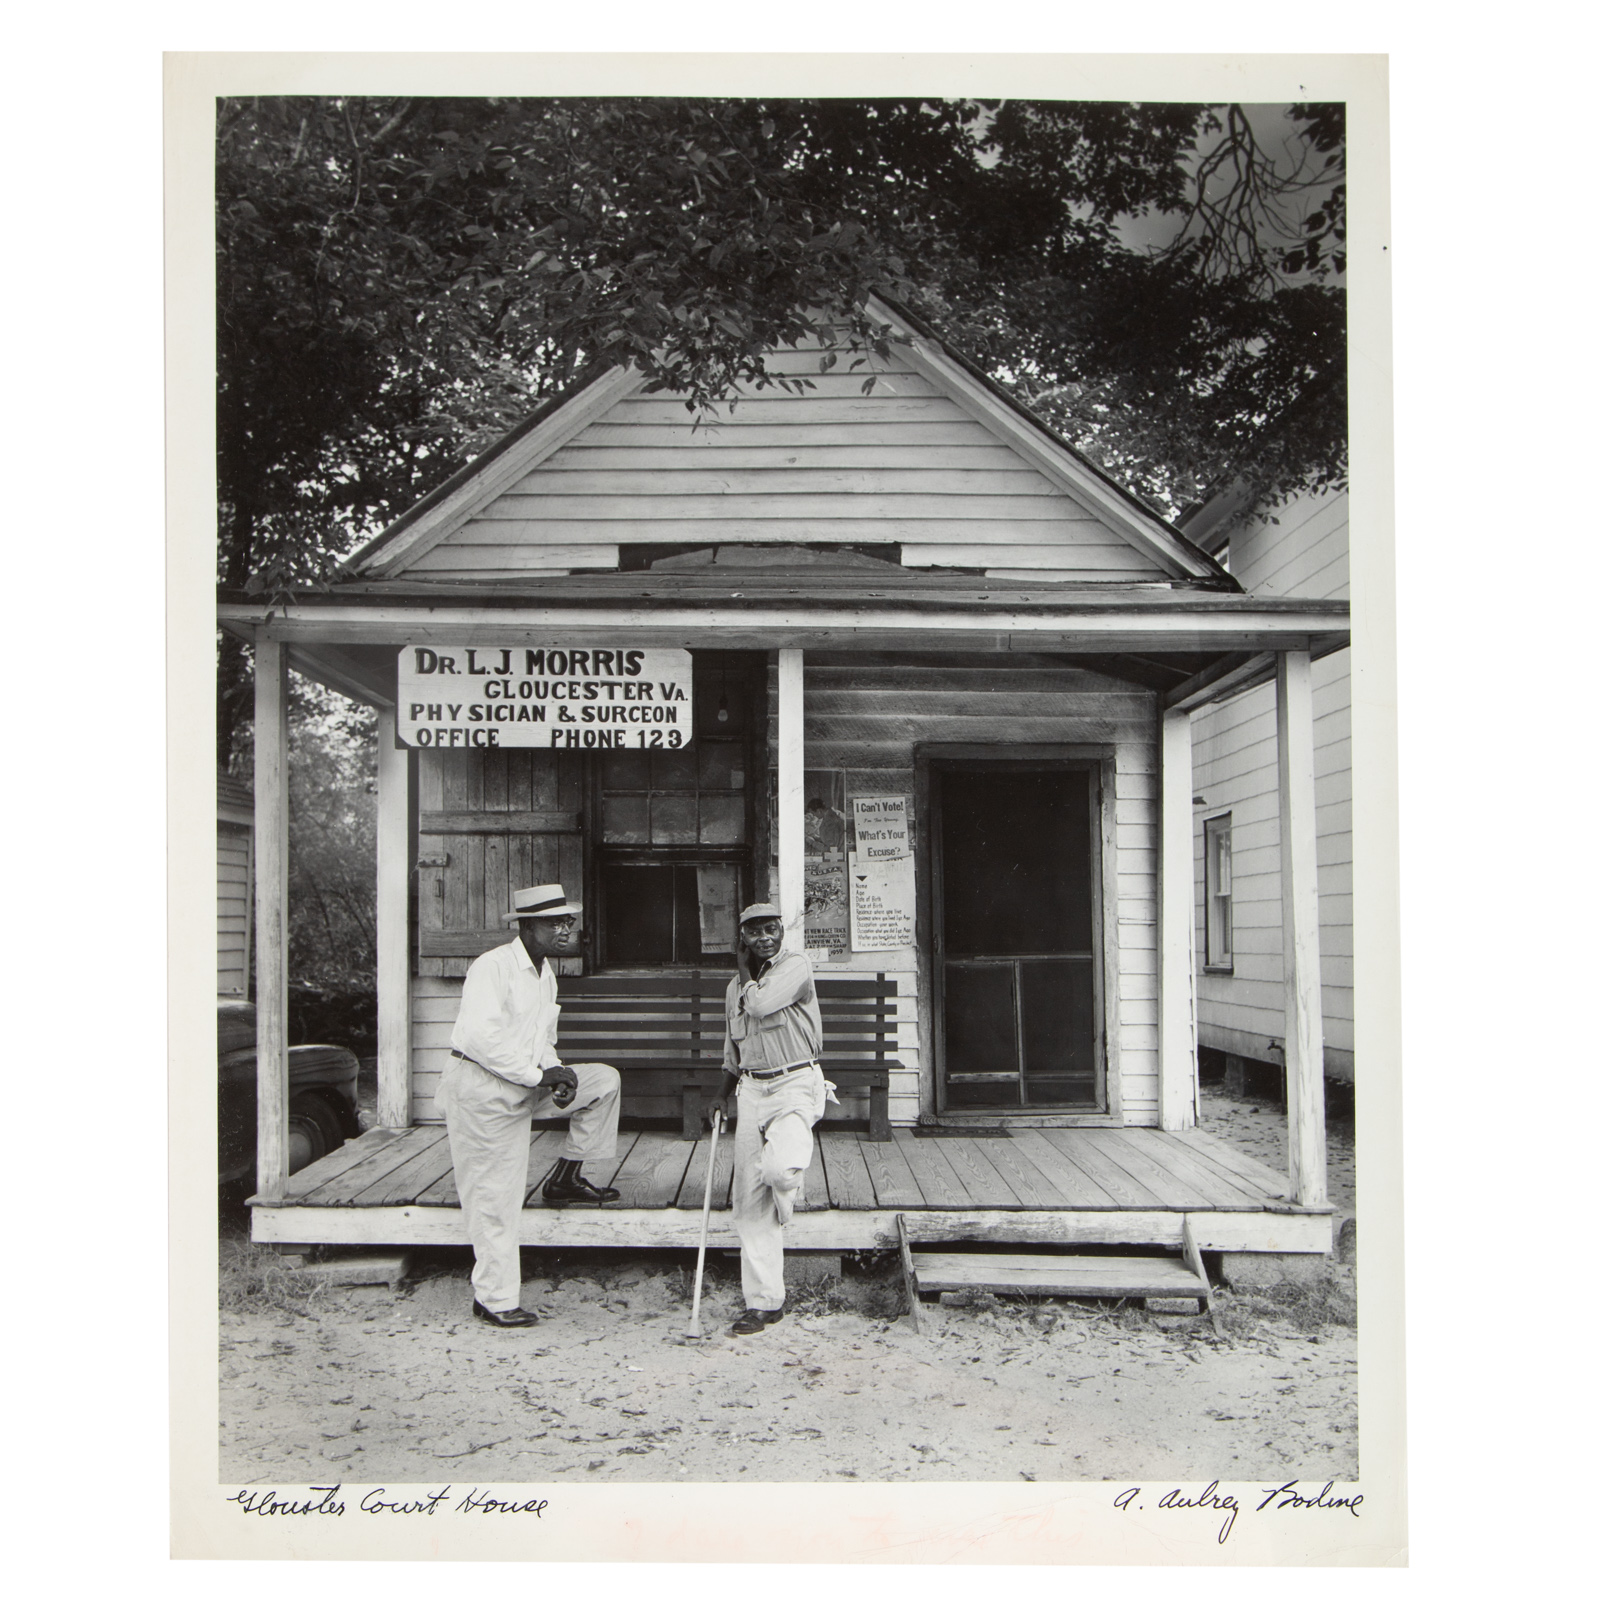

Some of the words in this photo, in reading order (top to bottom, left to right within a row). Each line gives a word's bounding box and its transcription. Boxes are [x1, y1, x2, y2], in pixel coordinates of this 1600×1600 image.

[415, 648, 462, 674] DR.
[525, 649, 645, 676] MORRIS
[485, 679, 653, 700] GLOUCESTER
[660, 682, 689, 701] VA.
[558, 704, 577, 723] &
[416, 728, 499, 748] OFFICE
[551, 729, 626, 748] PHONE
[637, 730, 683, 748] 123
[856, 803, 860, 813] I
[861, 802, 881, 813] Can't
[882, 801, 904, 812] Vote!
[858, 830, 886, 841] What's
[887, 829, 906, 840] Your
[867, 846, 901, 857] Excuse?
[360, 1485, 450, 1515] Court
[455, 1487, 548, 1518] House
